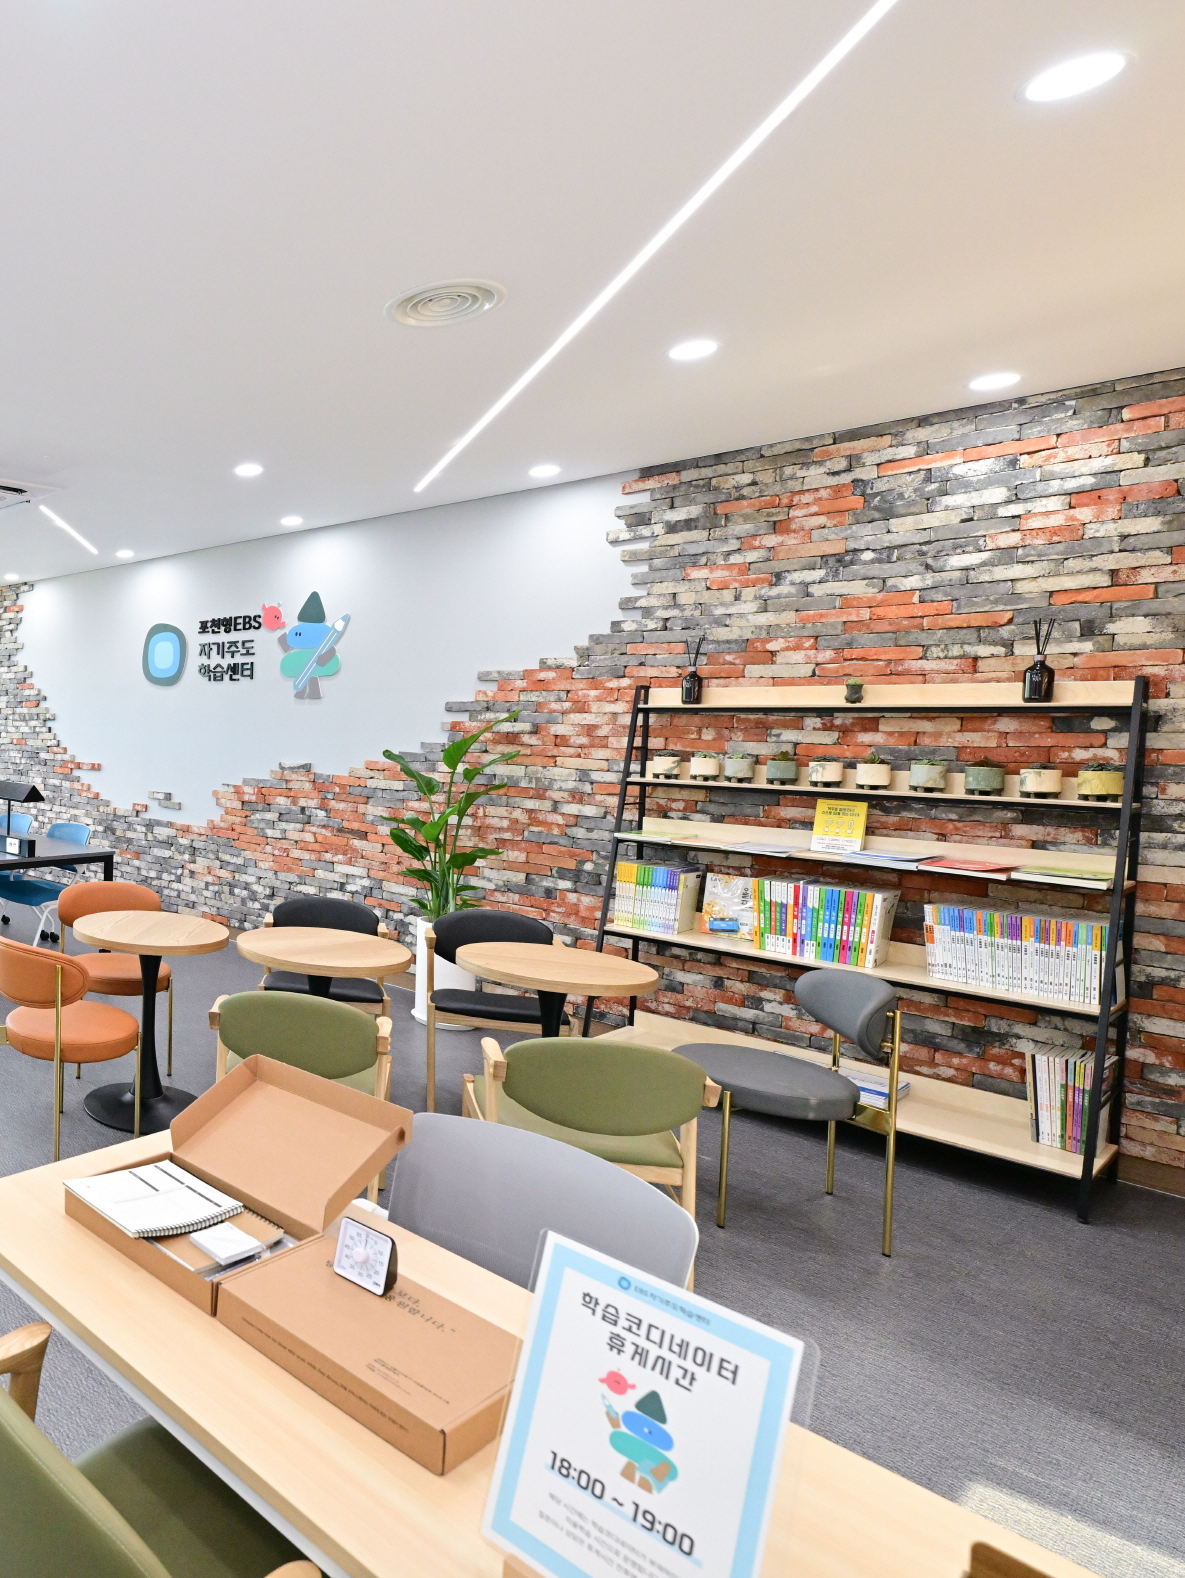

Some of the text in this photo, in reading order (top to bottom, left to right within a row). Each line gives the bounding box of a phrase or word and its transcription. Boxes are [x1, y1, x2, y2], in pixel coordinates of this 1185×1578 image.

[197, 614, 262, 634] 포천형EBS
[198, 639, 255, 660] 자기주도
[197, 661, 254, 682] 학습센터
[581, 1292, 740, 1386] 학습코디네이터
[606, 1331, 698, 1392] 휴게시간
[550, 1450, 605, 1500] 18:00
[632, 1500, 695, 1557] 19:00
